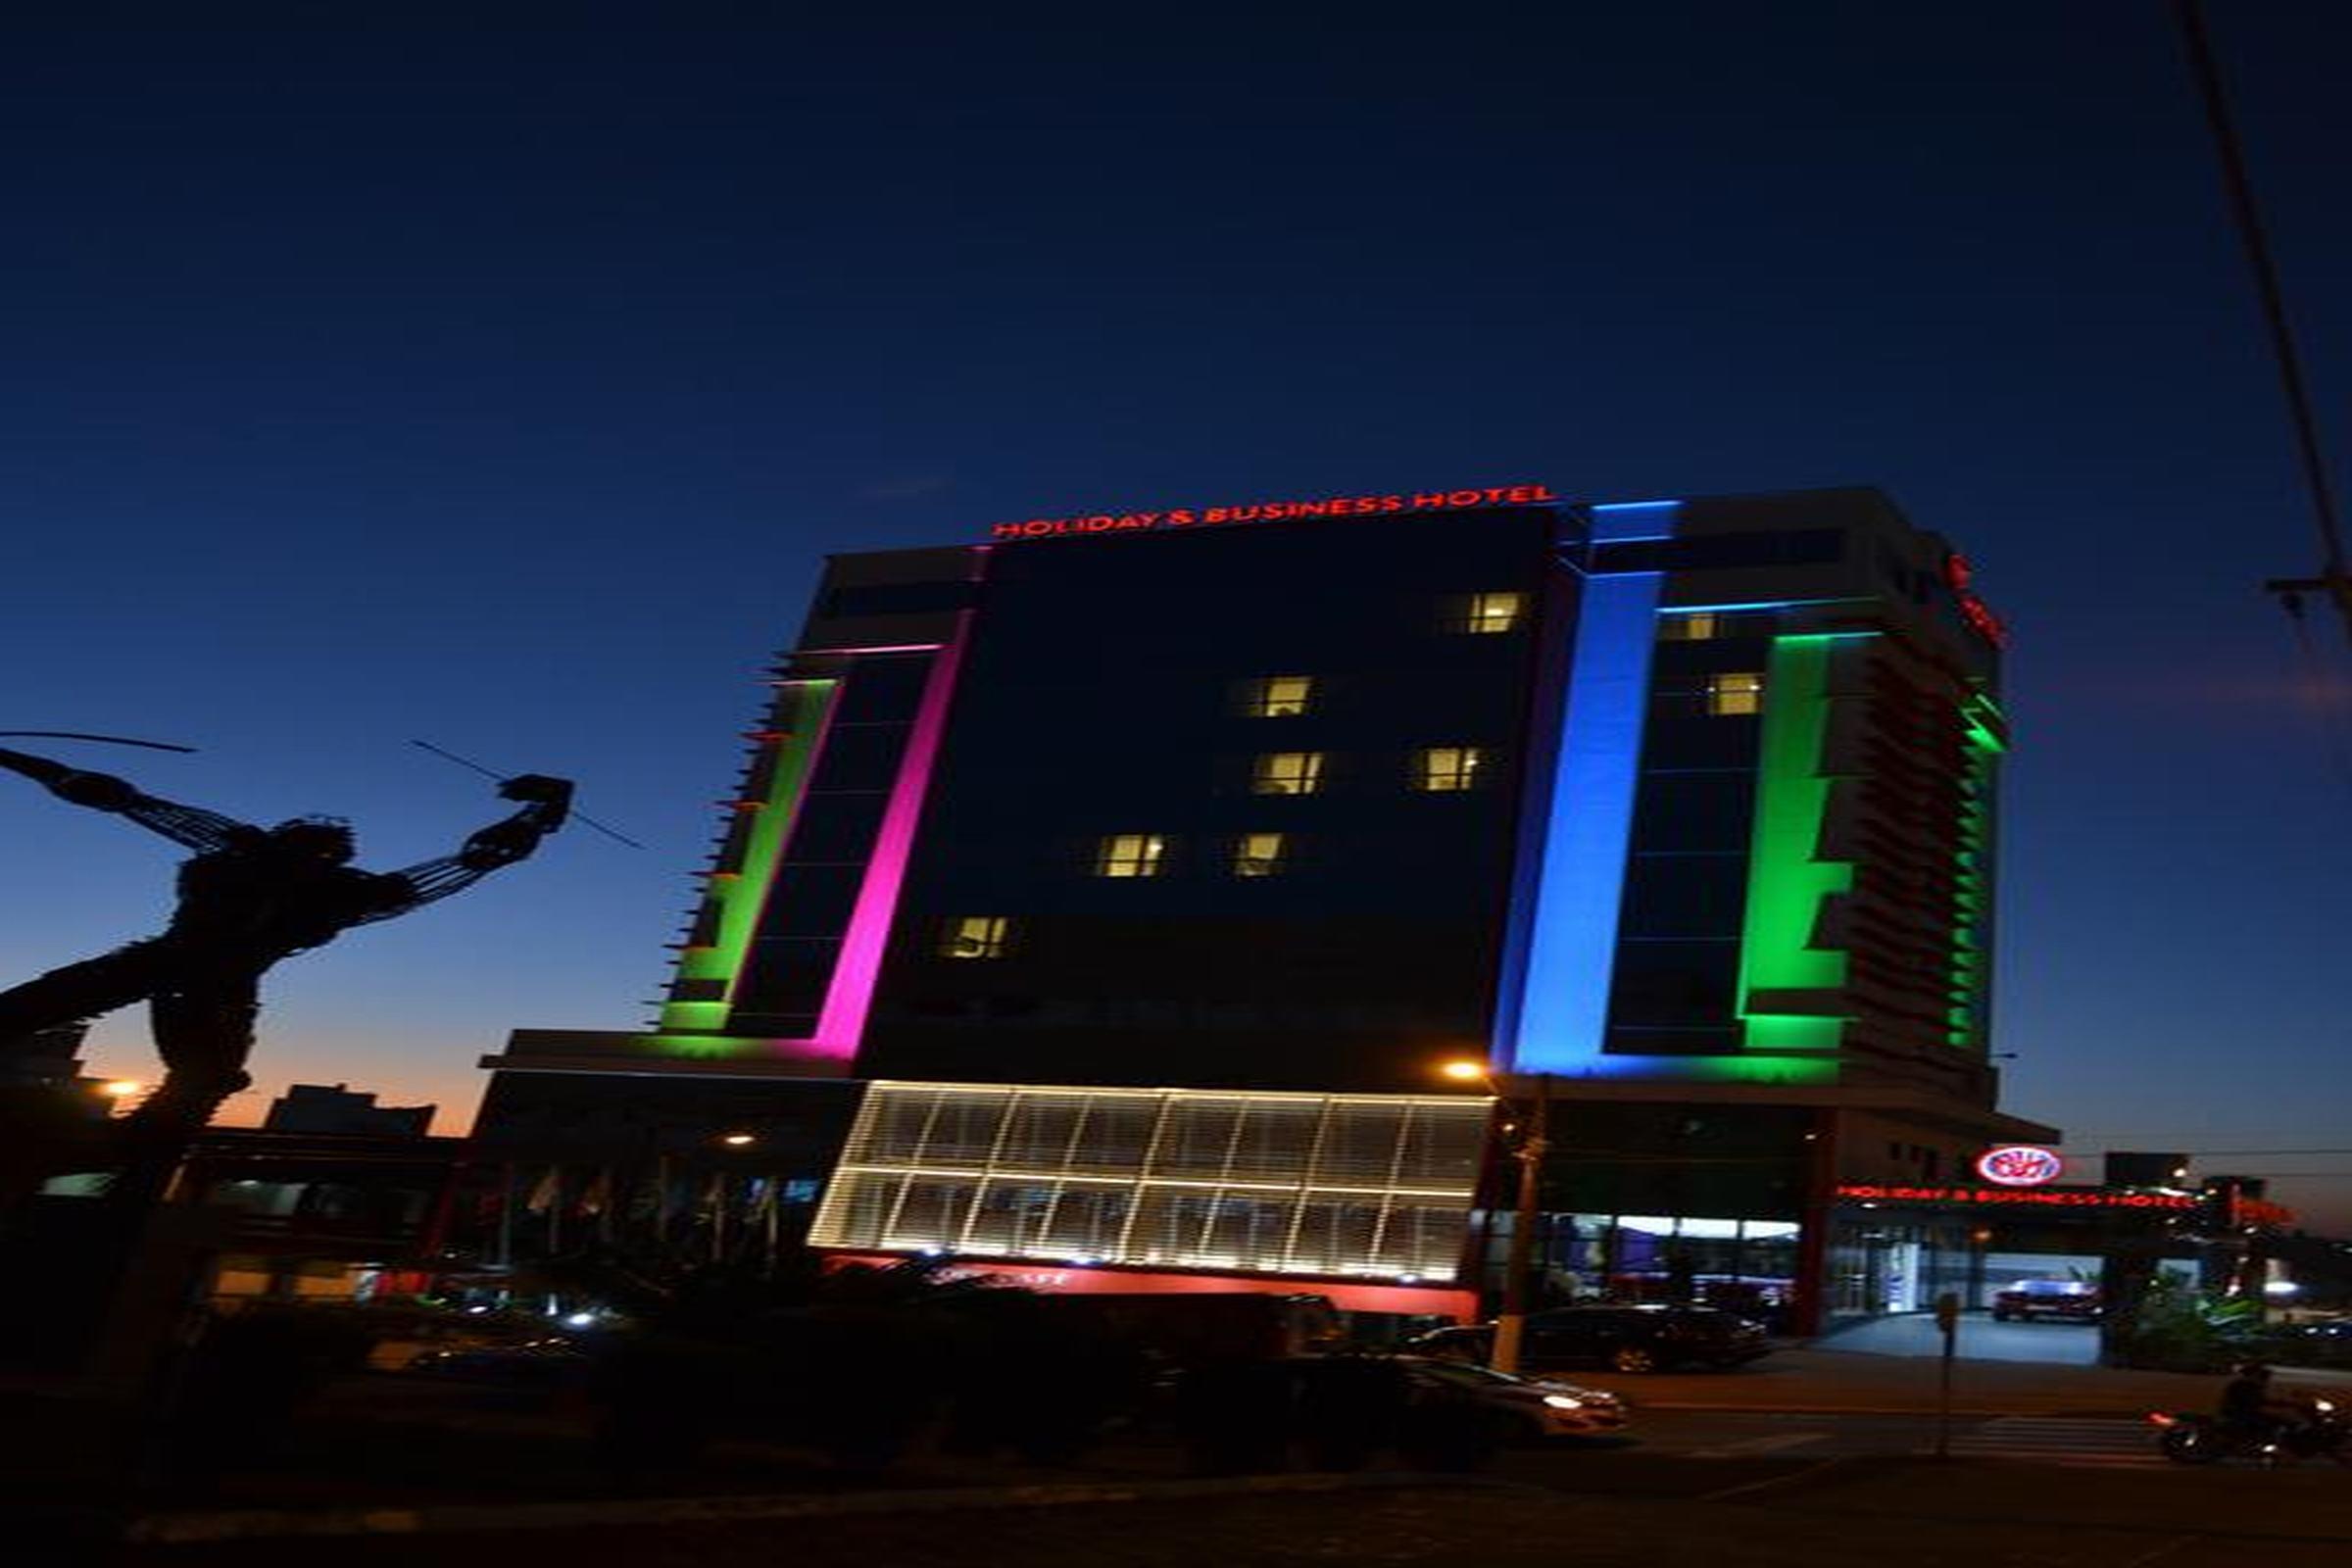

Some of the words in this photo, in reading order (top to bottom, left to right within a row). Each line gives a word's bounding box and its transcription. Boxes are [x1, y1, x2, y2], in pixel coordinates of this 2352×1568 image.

[991, 513, 1158, 536] HOLIDAY
[1204, 495, 1401, 524] BUSINESS
[1414, 486, 1552, 508] HOTEL
[1838, 1187, 1945, 1200] HOLIDAY
